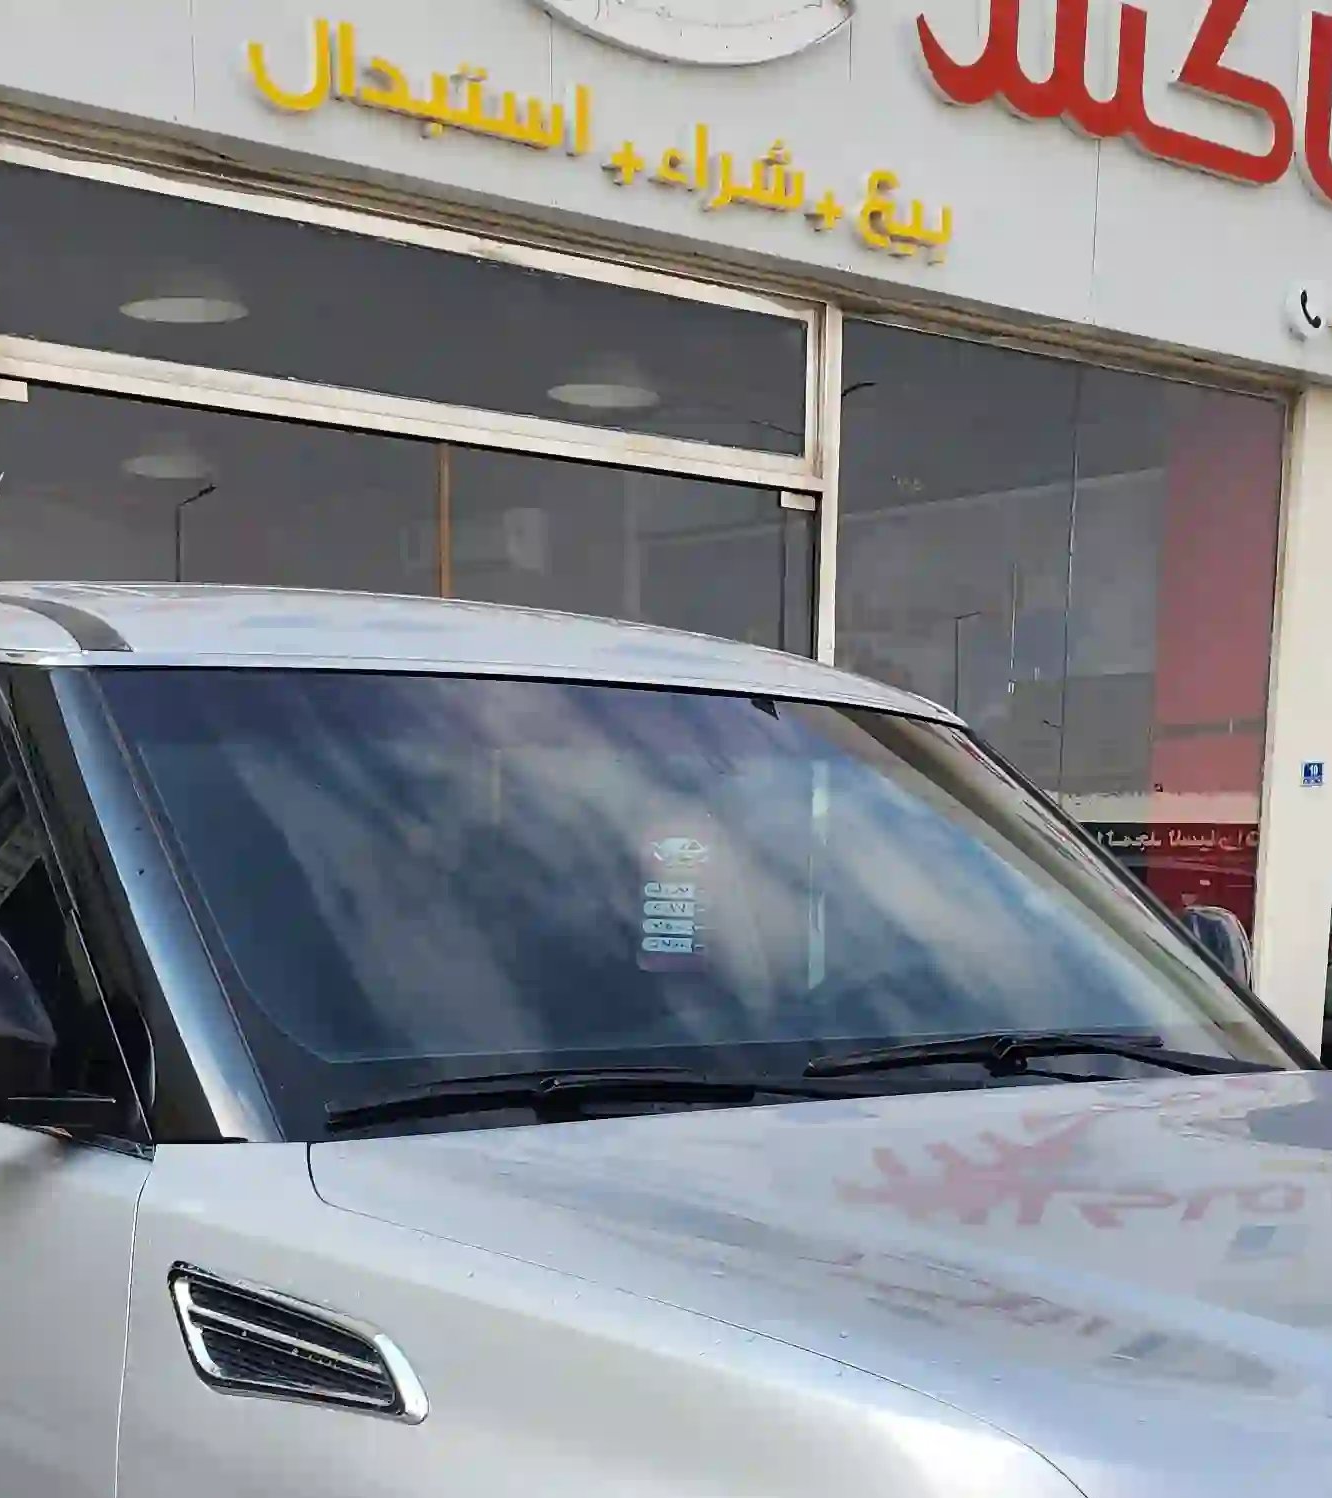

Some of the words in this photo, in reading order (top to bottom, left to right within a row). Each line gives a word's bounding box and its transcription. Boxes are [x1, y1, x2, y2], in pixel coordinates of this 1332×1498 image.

[246, 18, 591, 156] استبدال
[656, 122, 806, 212] شراء
[856, 170, 953, 264] بيع
